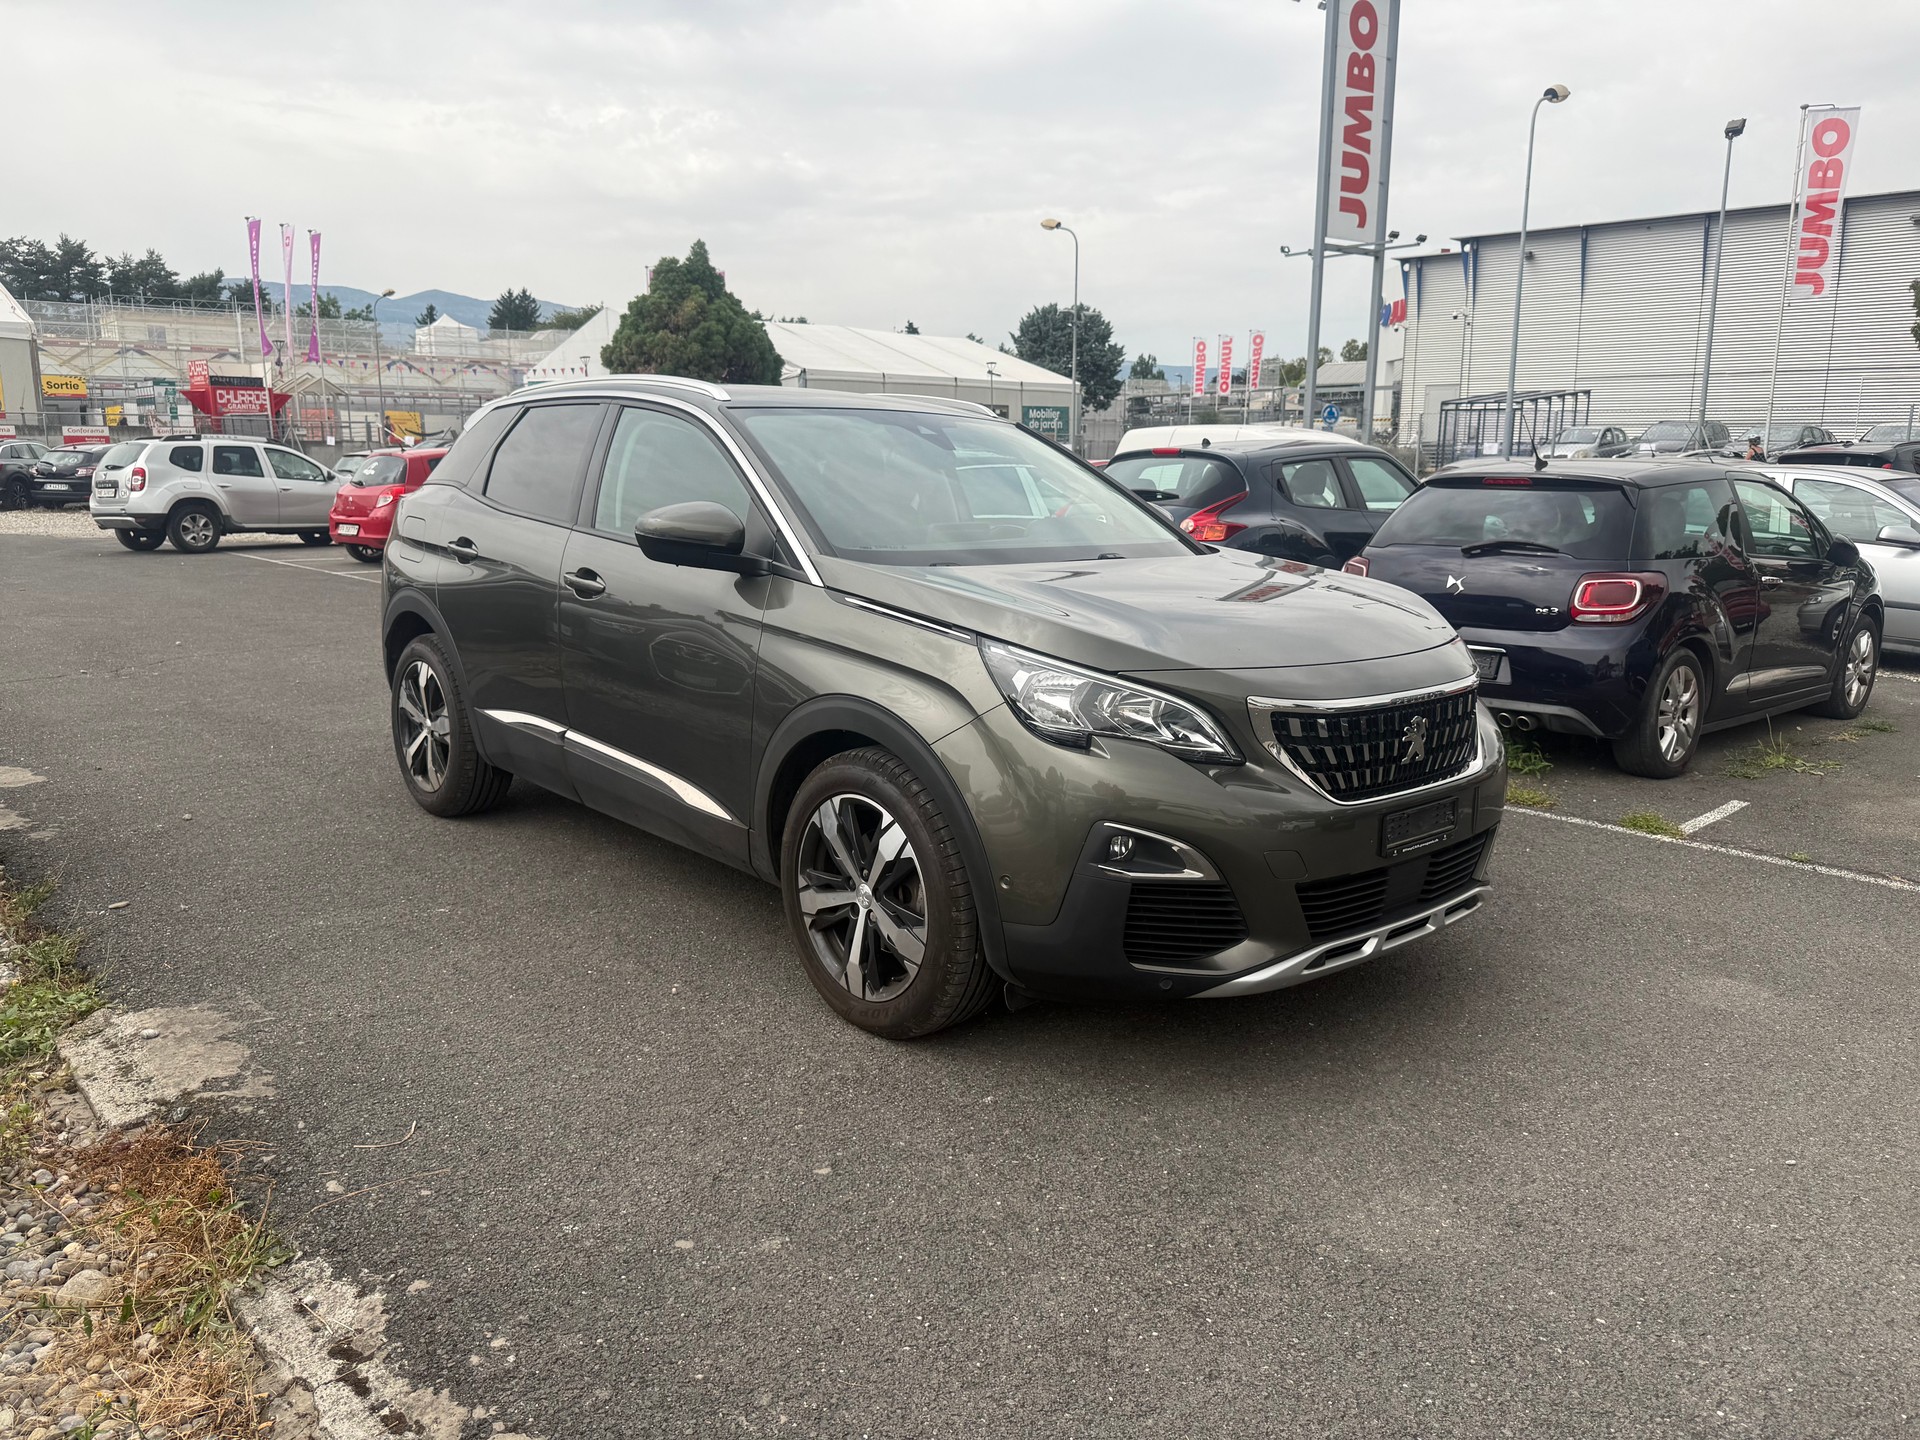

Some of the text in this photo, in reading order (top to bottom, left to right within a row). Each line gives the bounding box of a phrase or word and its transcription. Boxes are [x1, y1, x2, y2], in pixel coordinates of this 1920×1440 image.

[1339, 0, 1378, 229] JUMBO
[1795, 117, 1850, 296] JUMBO
[1195, 341, 1206, 394] JUMBO
[1251, 334, 1264, 389] JUMBO
[46, 380, 80, 390] Sortie
[217, 389, 267, 404] CHURROS
[1029, 408, 1060, 419] Mobilier
[67, 427, 104, 435] Conforama
[1029, 419, 1063, 431] de jardn
